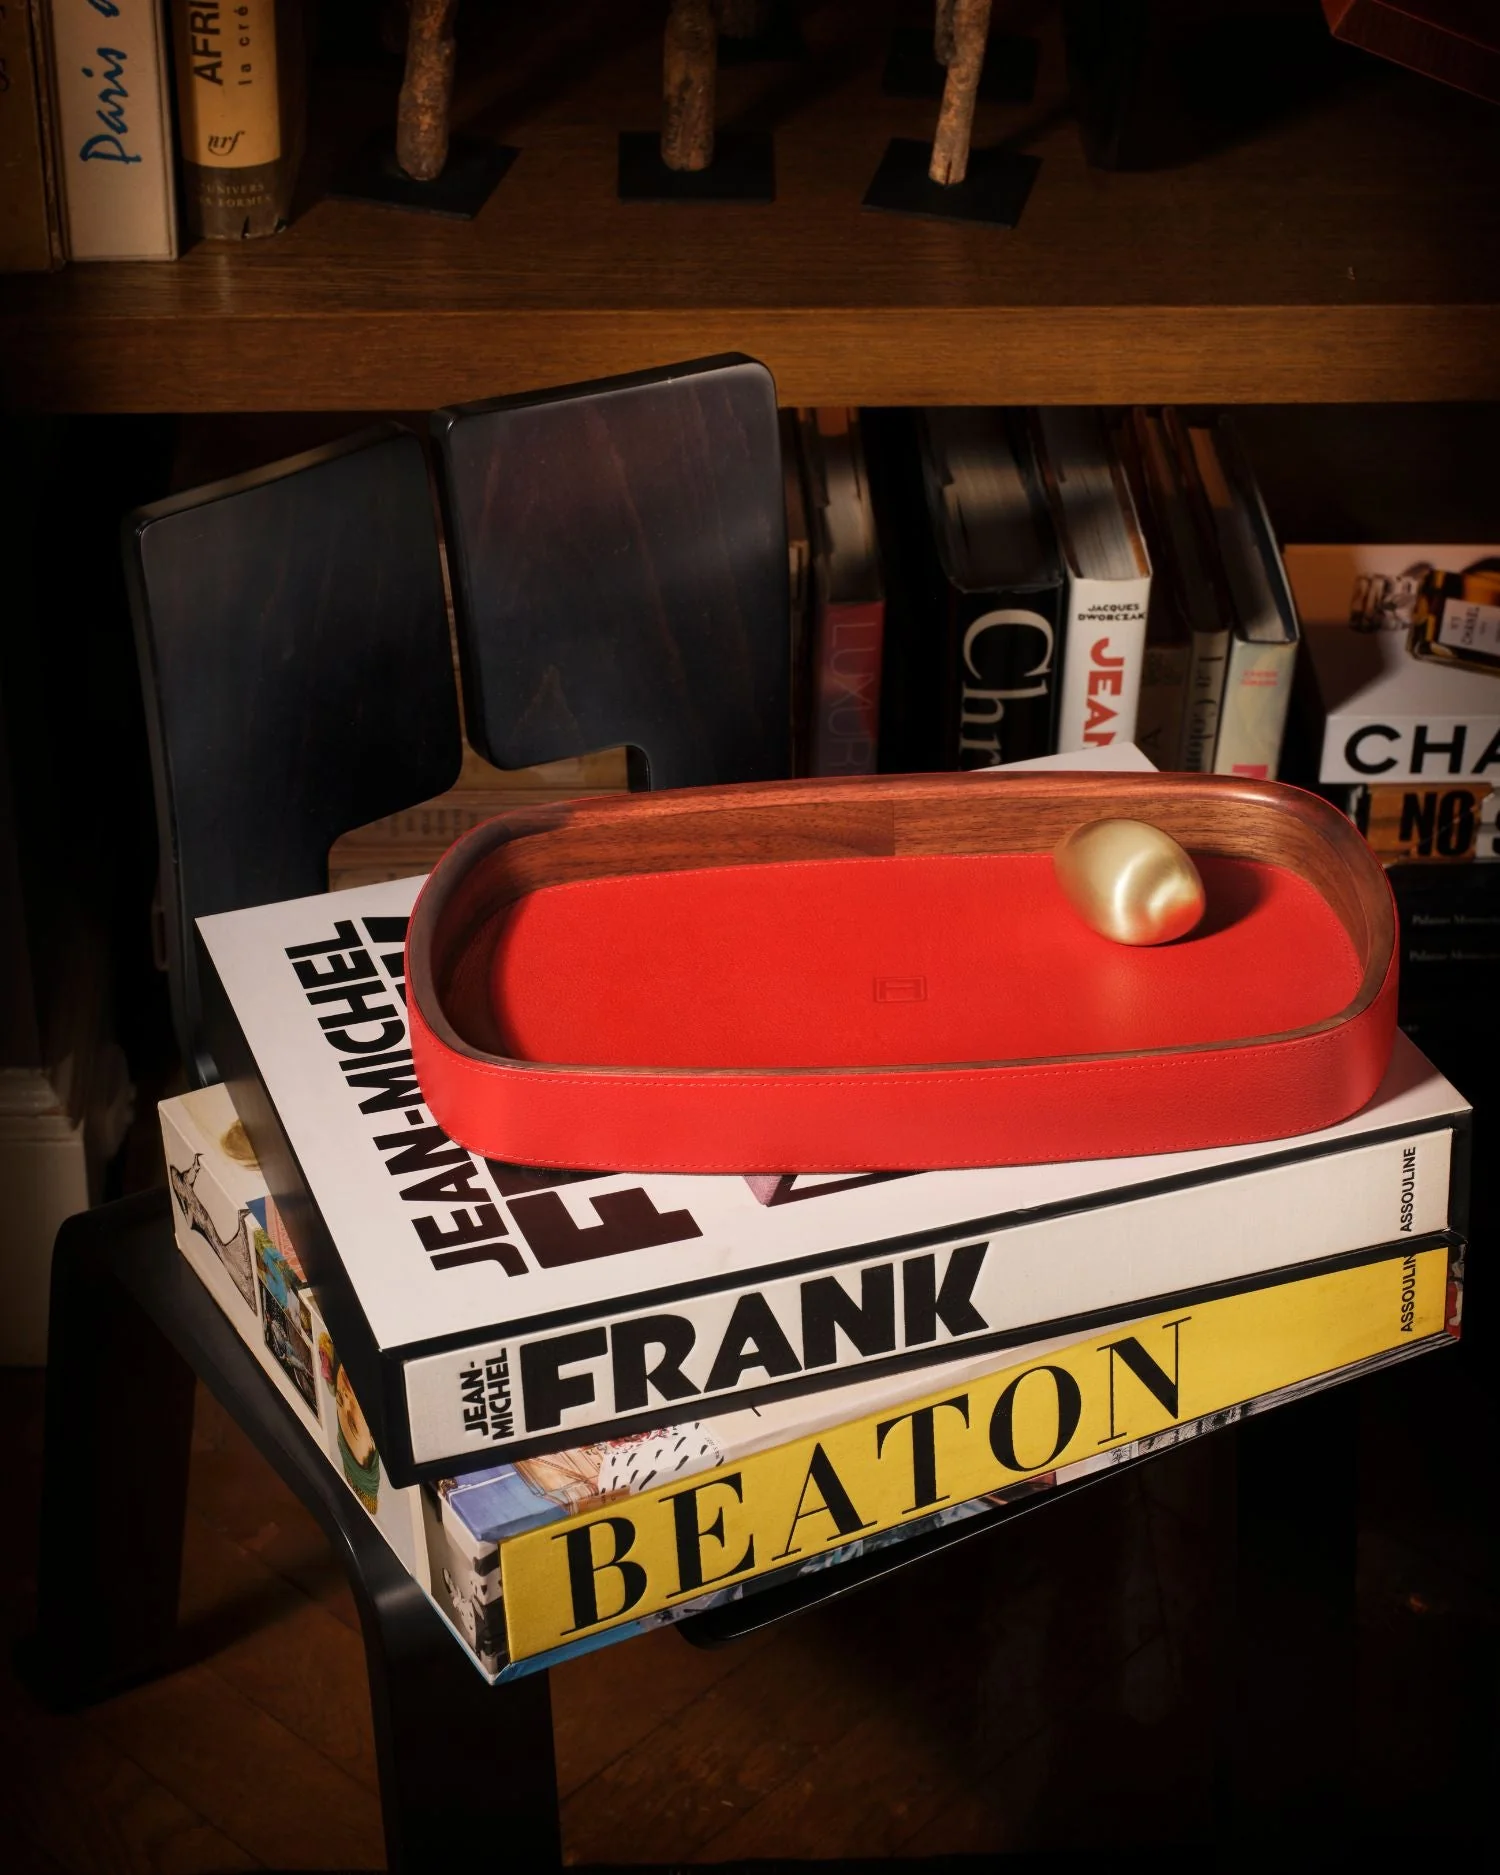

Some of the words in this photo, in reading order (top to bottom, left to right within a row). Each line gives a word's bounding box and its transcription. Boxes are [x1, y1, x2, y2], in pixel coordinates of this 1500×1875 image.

[189, 1, 223, 86] AFRI
[238, 63, 252, 85] la
[79, 48, 142, 164] Paris
[207, 130, 246, 156] nrf
[1077, 612, 1146, 622] DWORCZAK
[1087, 603, 1140, 613] JACQUES
[284, 919, 530, 1278] JEAN-MICHEL
[1400, 1146, 1417, 1233] ASSOULINE
[520, 1241, 990, 1432] FRANK
[460, 1361, 489, 1437] JEAN-
[486, 1348, 514, 1440] MICHEL
[550, 1316, 1193, 1638] BEATON
